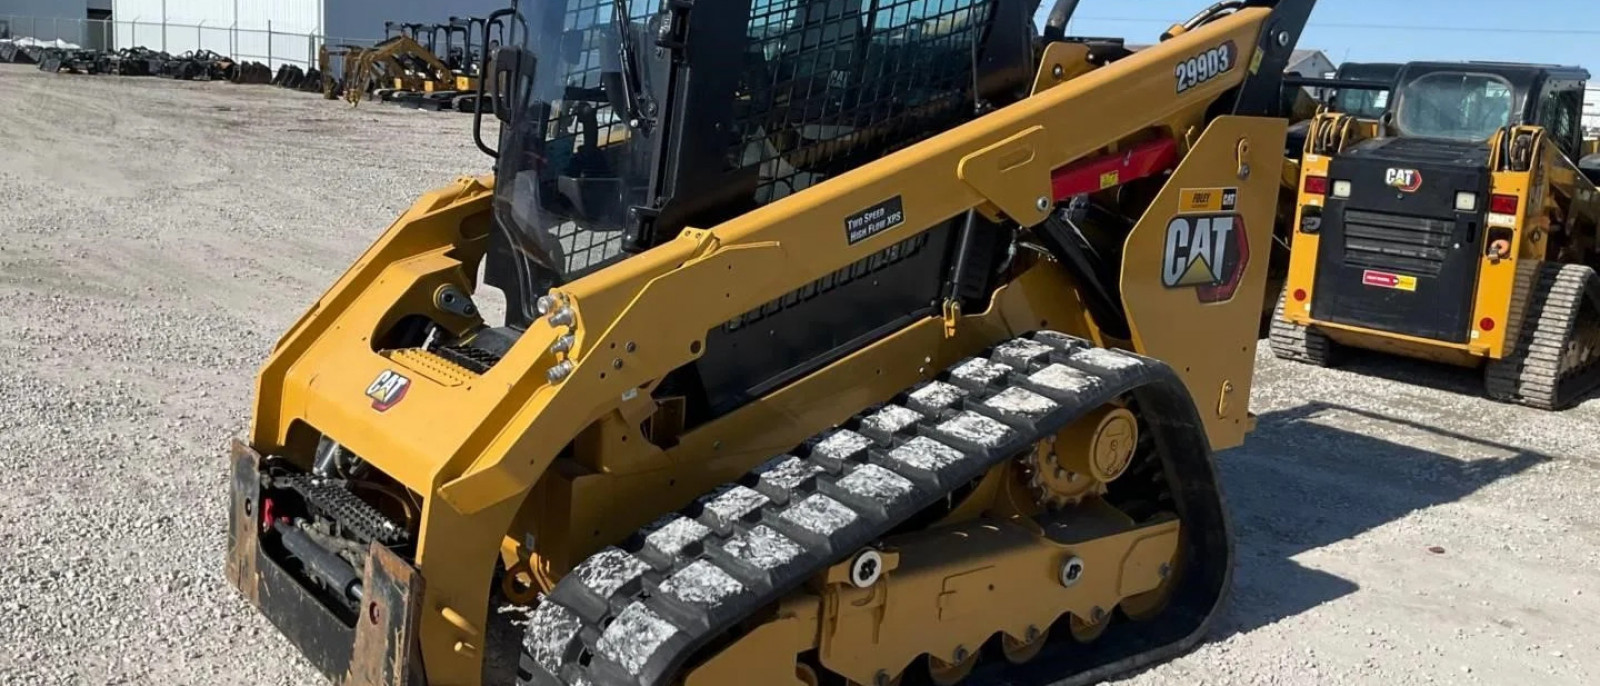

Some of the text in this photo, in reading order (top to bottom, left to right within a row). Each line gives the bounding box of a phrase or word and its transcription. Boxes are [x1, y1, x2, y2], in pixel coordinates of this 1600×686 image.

[1176, 45, 1229, 92] 299D3
[1385, 168, 1414, 186] CAT
[1222, 193, 1235, 206] CAT
[847, 208, 885, 230] TWO SPEED
[850, 211, 901, 243] HIGH FLOW XPS
[1163, 217, 1234, 286] CAT
[367, 370, 408, 403] CAT
